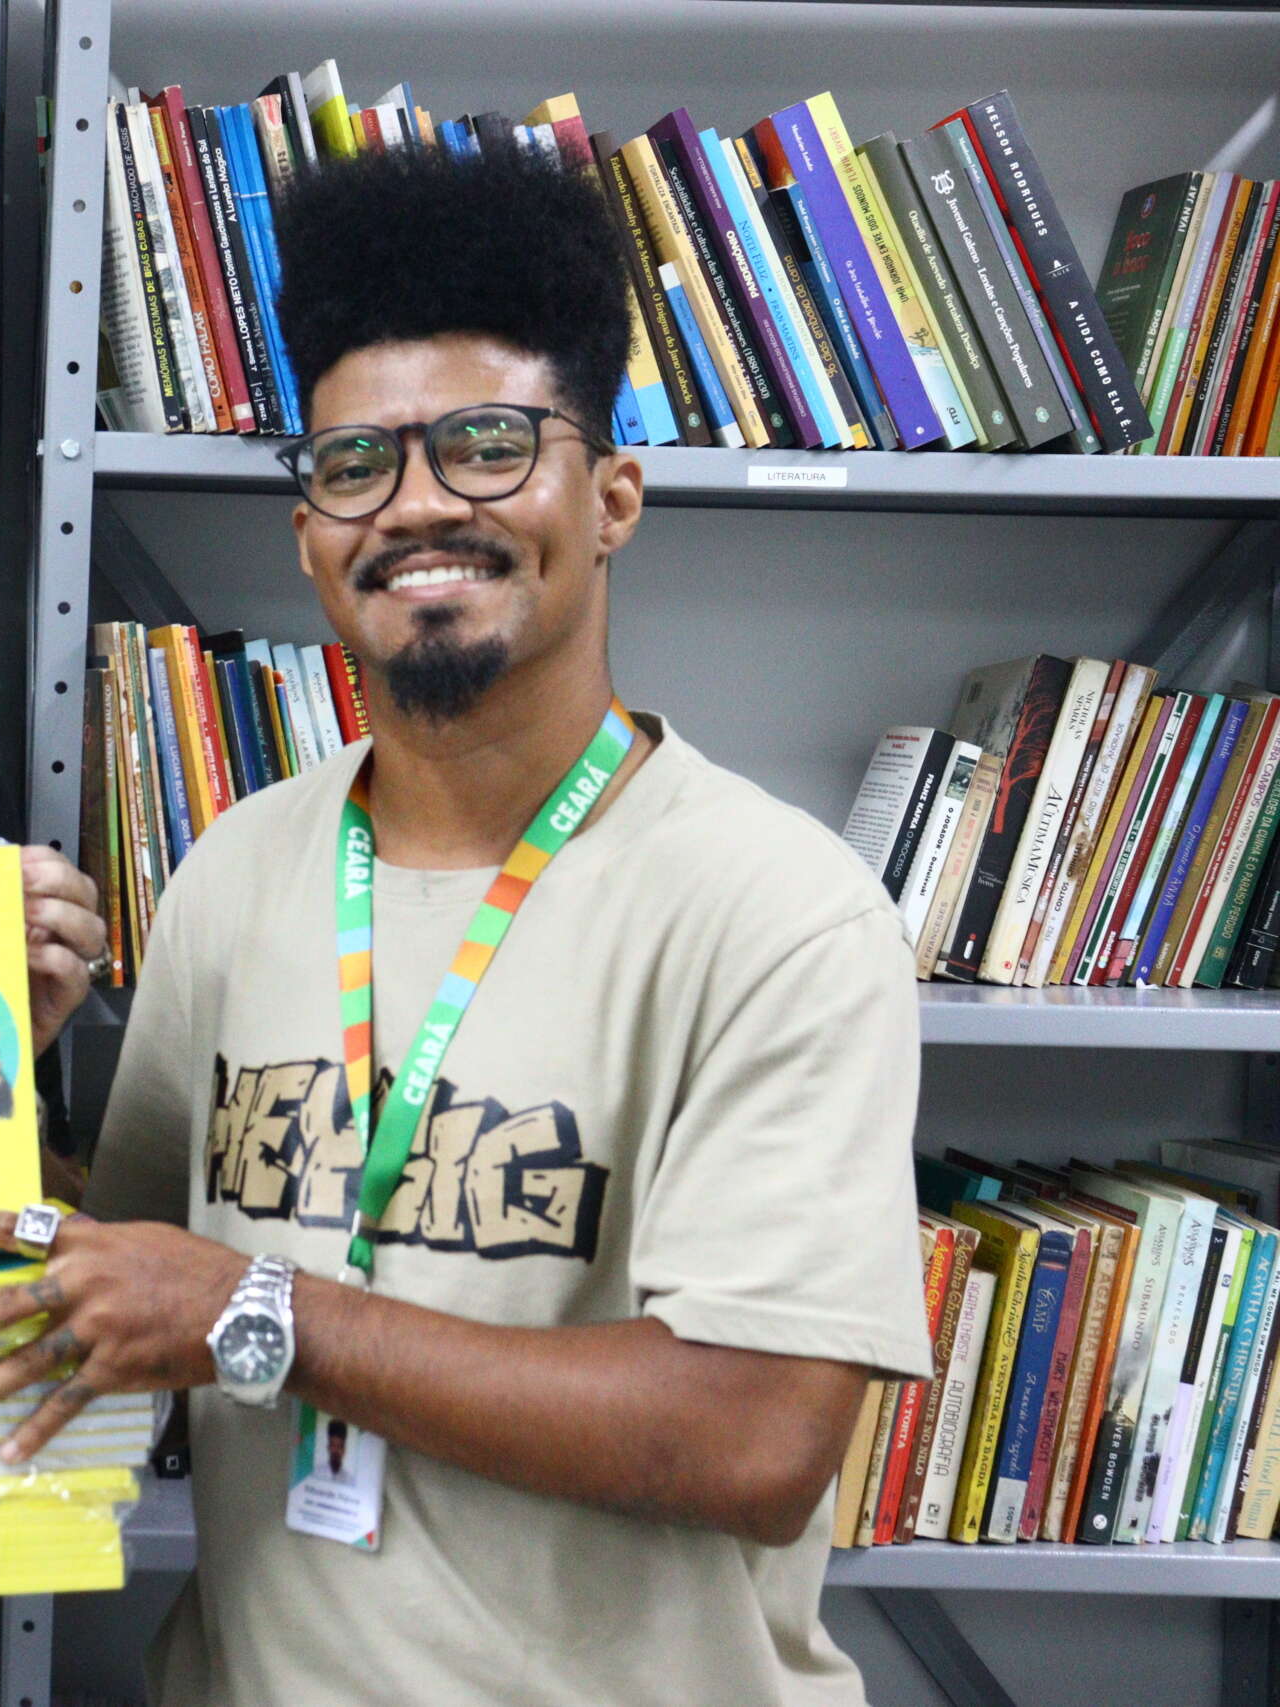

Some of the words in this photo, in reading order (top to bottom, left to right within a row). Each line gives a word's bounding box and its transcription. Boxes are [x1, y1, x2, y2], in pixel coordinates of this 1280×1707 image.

[119, 126, 131, 150] ASSIS
[196, 138, 207, 152] Sul
[124, 152, 134, 165] DE
[199, 152, 210, 164] do
[211, 146, 230, 182] Mágica
[609, 156, 628, 193] Eduardo
[984, 104, 1014, 156] NELSON
[1008, 161, 1048, 237] RODRIGUES
[126, 167, 142, 211] MACHADO
[202, 165, 217, 193] Lendas
[667, 166, 697, 221] Sociabilidade
[220, 182, 235, 213] Luneta
[647, 163, 666, 198] FORTALEZA
[661, 199, 681, 235] ENCANTADA
[851, 182, 872, 214] MUNDOS
[945, 196, 969, 233] Juvenal
[211, 199, 231, 247] Gauchescos
[227, 213, 237, 222] A
[632, 227, 642, 237] B.
[863, 212, 879, 231] DOIS
[907, 209, 928, 243] Otacílio
[1177, 205, 1192, 233] IVAN
[135, 219, 149, 251] CUBAS
[634, 237, 646, 249] de
[692, 227, 713, 259] Cultura
[737, 219, 760, 253] NOITE
[750, 251, 771, 281] FELIZ
[871, 230, 889, 254] ENTRE
[921, 242, 933, 254] de
[961, 230, 983, 264] Galeno
[139, 252, 153, 278] BRÁS
[222, 248, 236, 277] Contos
[638, 250, 657, 288] Menezes
[706, 259, 719, 275] das
[722, 229, 760, 299] PANDEMÔNIO
[782, 253, 801, 283] cama
[880, 252, 902, 286] JORNADA
[926, 254, 948, 290] Azevedo
[145, 280, 156, 292] DE
[228, 277, 242, 304] NETO
[651, 292, 662, 302] O
[712, 275, 729, 298] Elites
[792, 283, 807, 300] da
[894, 284, 909, 303] UMA
[977, 266, 998, 300] Lendas
[146, 295, 165, 345] PÓSTUMAS
[653, 301, 672, 336] Enigma
[799, 298, 824, 341] embaixo
[942, 293, 966, 333] Fortaleza
[990, 299, 998, 307] e
[191, 311, 211, 354] FALAR
[235, 306, 250, 339] LOPES
[722, 298, 749, 347] Sobralenses
[992, 305, 1017, 344] Canções
[1146, 306, 1163, 335] boca
[665, 335, 676, 347] do
[815, 339, 833, 363] dias
[957, 332, 982, 371] Descalça
[1147, 338, 1154, 346] a
[155, 347, 174, 397] MEMÓRIAS
[202, 356, 221, 397] COMO
[741, 346, 771, 400] (1880-1930)
[1007, 342, 1036, 389] Populares
[1068, 299, 1080, 309] A
[1074, 313, 1095, 345] VIDA
[1089, 348, 1112, 386] COMO
[1107, 390, 1124, 415] ELA
[1118, 418, 1138, 445] É...
[1136, 347, 1152, 375] Boca
[675, 369, 694, 404] Caboclo
[767, 472, 826, 480] LITERATURA
[161, 689, 175, 735] EMINESCU
[1066, 693, 1085, 731] SPARKS
[1072, 689, 1096, 741] NICHOLAS
[1226, 714, 1241, 734] Jean
[169, 744, 182, 778] LUCIAN
[1218, 734, 1234, 760] Little
[174, 779, 186, 808] BLAGA
[549, 760, 610, 833] CEARÁ
[918, 773, 935, 802] FRANZ
[1249, 762, 1274, 808] CAMPOS
[1263, 778, 1280, 816] EUCLIDES
[180, 818, 191, 839] DOIS
[908, 801, 925, 830] KAFKA
[1191, 823, 1202, 834] O
[1258, 815, 1272, 829] DA
[905, 830, 914, 839] O
[1177, 832, 1198, 865] presente
[1249, 827, 1268, 856] CUNHA
[345, 825, 373, 899] CEARÁ
[891, 838, 911, 878] PROCESSO
[1175, 865, 1187, 876] de
[1244, 862, 1256, 871] O
[1247, 856, 1258, 864] E
[1052, 880, 1069, 912] CONTOS
[1163, 876, 1183, 908] ANNA
[1232, 870, 1255, 907] PARAÍSO
[923, 899, 948, 960] FRANCESES
[1220, 905, 1241, 940] PERDIDO
[402, 1010, 453, 1107] CEARÁ
[948, 1237, 973, 1286] Agatha
[1012, 1247, 1033, 1290] Agatha
[961, 1280, 981, 1321] AGATHA
[1243, 1256, 1271, 1326] AGATHA
[933, 1288, 964, 1361] Christie
[1000, 1289, 1025, 1349] Christie
[1029, 1286, 1058, 1335] CAMP
[1084, 1270, 1114, 1354] AGATHA
[1129, 1276, 1156, 1352] SUBMUNDO
[1166, 1284, 1187, 1345] RENEGADO
[953, 1321, 974, 1363] CHRISTIE
[935, 1365, 945, 1375] A
[1051, 1352, 1069, 1383] MARY
[1224, 1327, 1254, 1408] CHRISTIE
[905, 1381, 917, 1405] ASA
[924, 1377, 942, 1422] MORTE
[988, 1354, 1011, 1421] AVENTURA
[1066, 1356, 1096, 1450] CHRISTIE
[897, 1407, 912, 1449] TORTA
[920, 1424, 932, 1441] NO
[932, 1379, 965, 1477] AUTOBIOGRAFIA
[984, 1424, 995, 1443] EM
[1035, 1390, 1062, 1463] WESTMACOTT
[913, 1445, 928, 1476] NILO
[974, 1447, 993, 1489] BAGDÁ
[1100, 1451, 1117, 1501] BOWDEN
